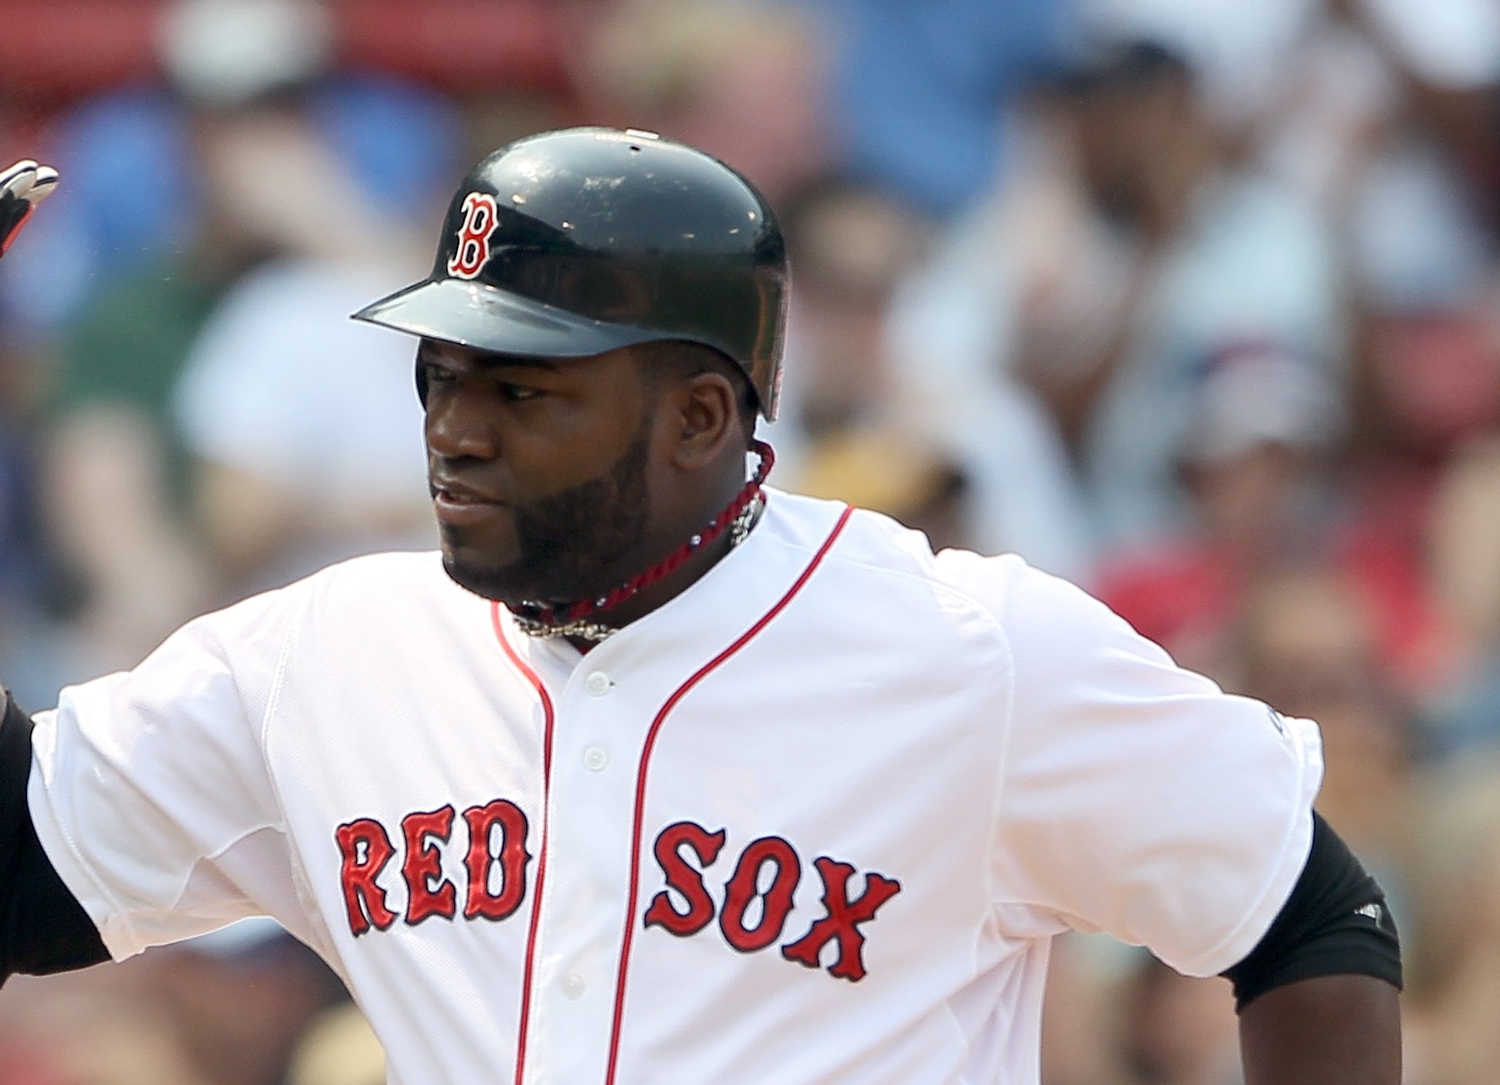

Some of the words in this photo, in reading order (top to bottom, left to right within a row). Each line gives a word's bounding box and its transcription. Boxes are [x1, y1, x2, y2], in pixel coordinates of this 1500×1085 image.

[447, 191, 500, 280] B
[335, 798, 533, 939] RED
[643, 820, 902, 983] SOX
